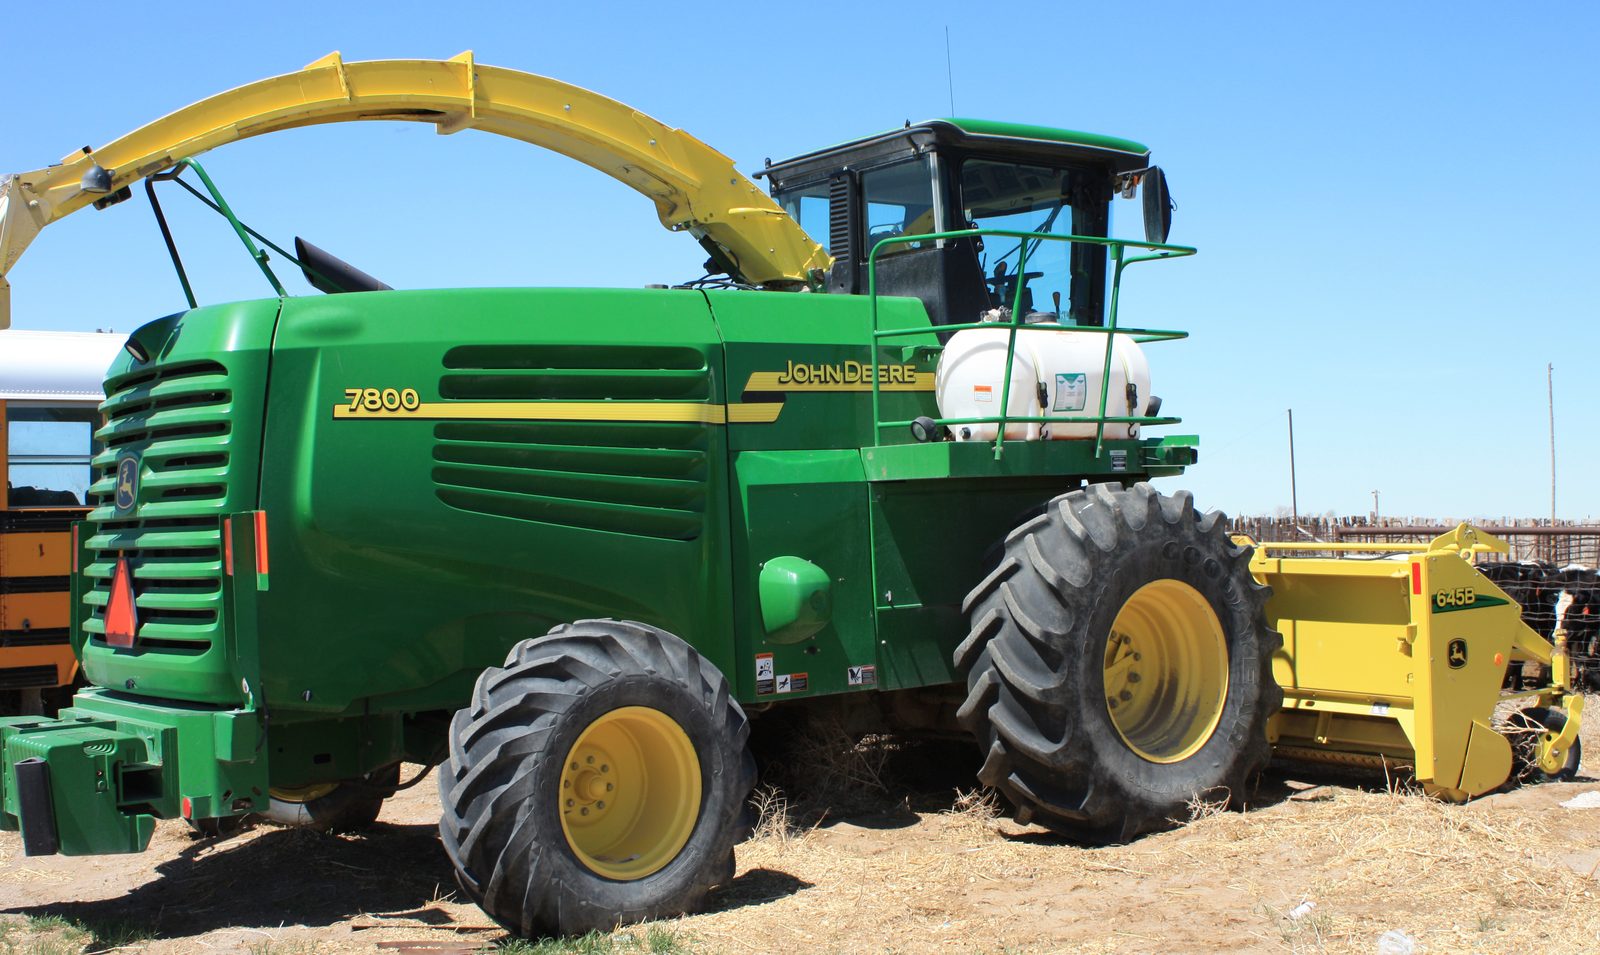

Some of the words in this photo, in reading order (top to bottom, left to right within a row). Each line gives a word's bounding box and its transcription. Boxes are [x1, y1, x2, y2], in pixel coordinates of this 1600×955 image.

[778, 359, 841, 384] JOHN
[843, 360, 916, 384] DEERE
[344, 388, 420, 412] 7800
[1436, 587, 1476, 608] 645B
